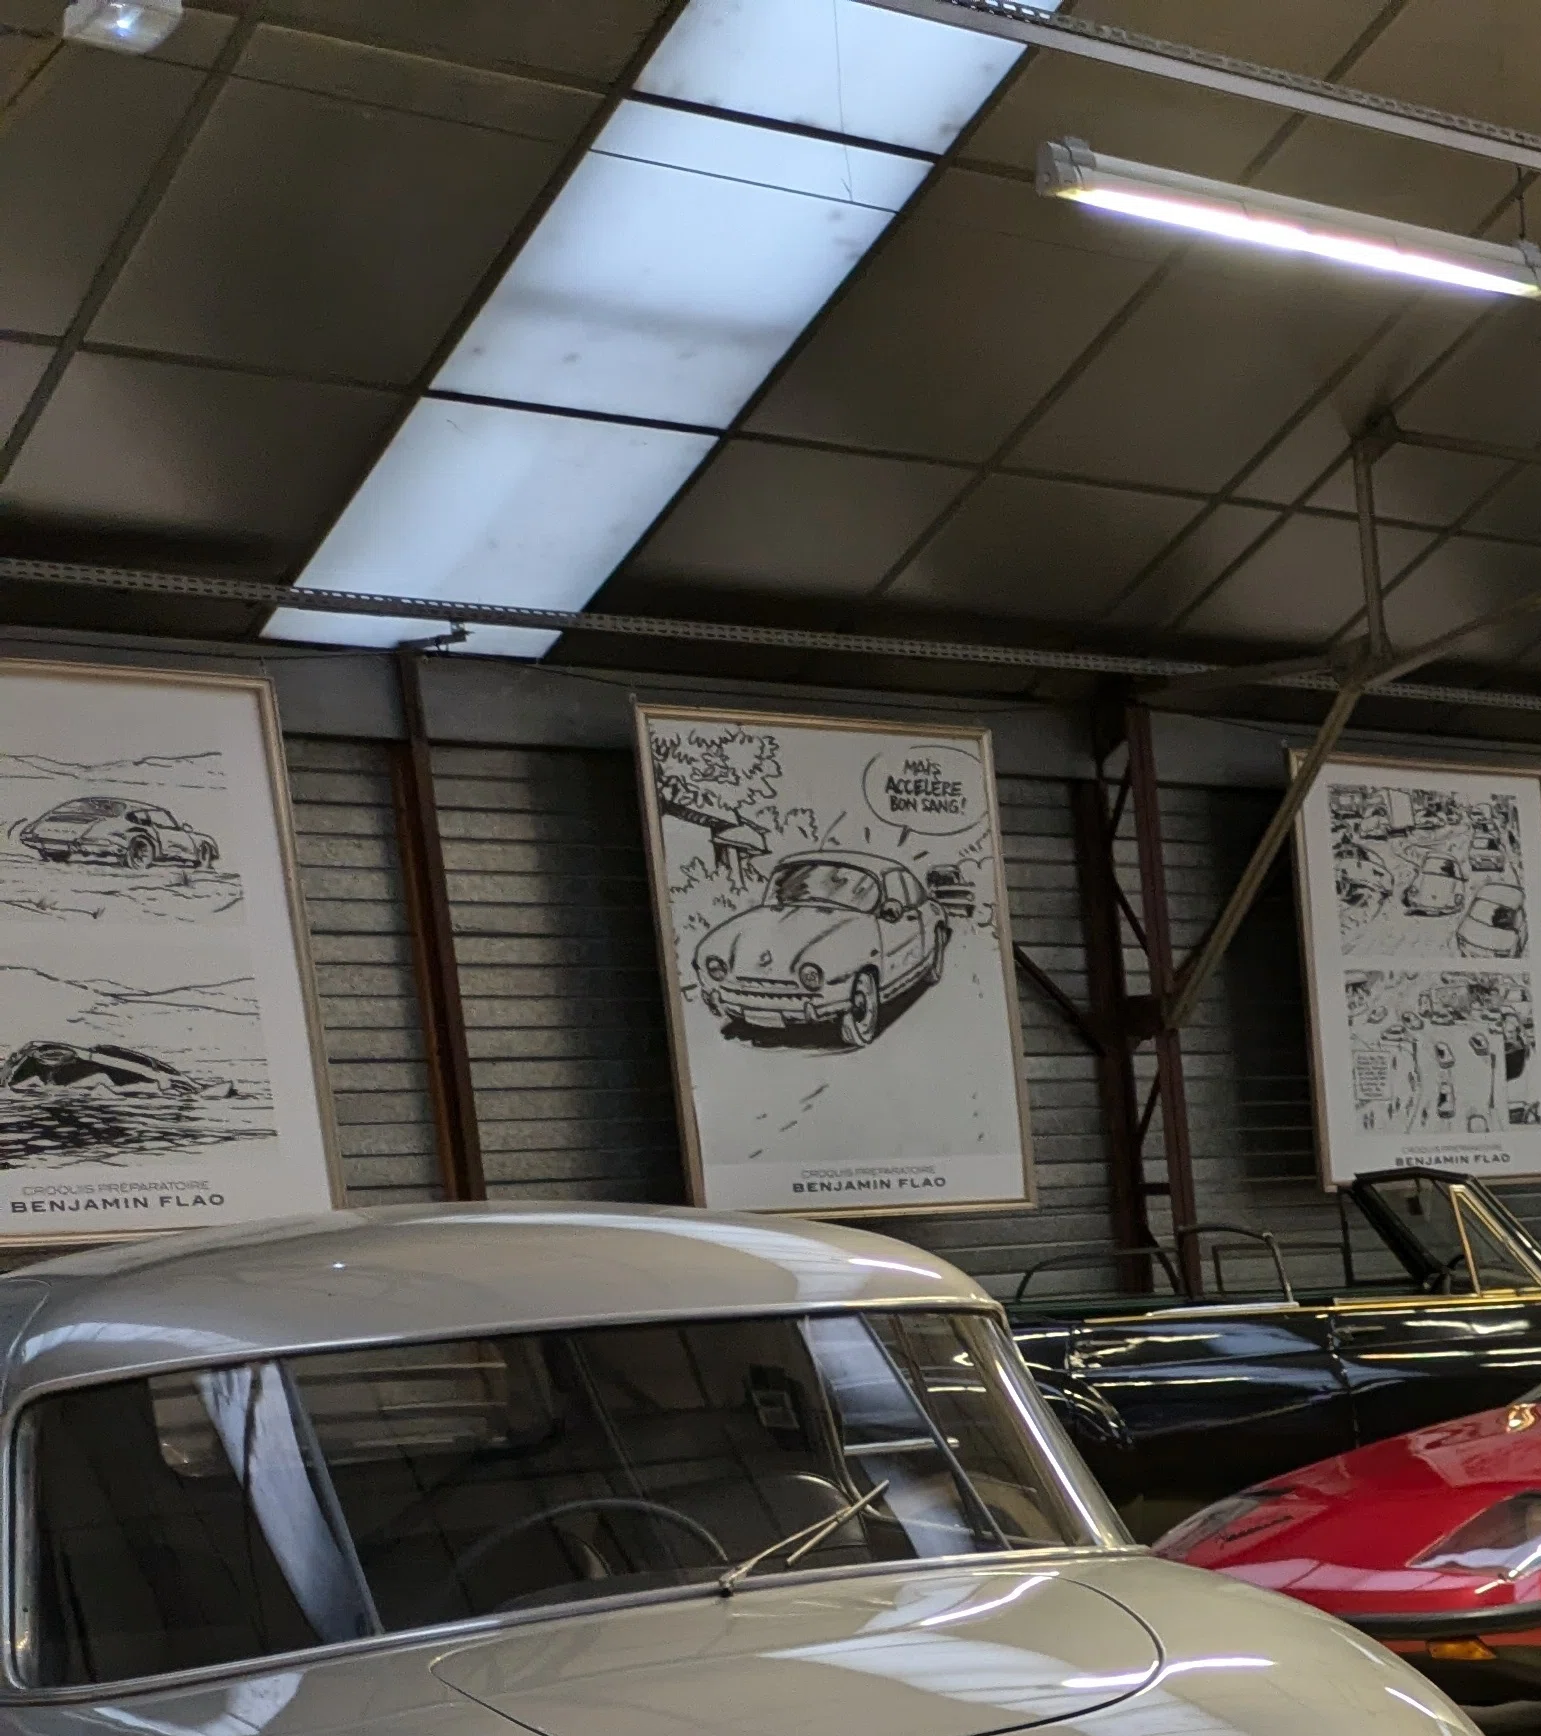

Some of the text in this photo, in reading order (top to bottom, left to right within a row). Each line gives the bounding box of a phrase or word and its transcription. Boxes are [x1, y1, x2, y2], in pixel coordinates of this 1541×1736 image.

[890, 795, 917, 812] BON
[1395, 1154, 1469, 1167] BENJAMIN
[22, 1183, 93, 1197] CROQUIS
[792, 1176, 946, 1193] BENJAMIN FLAO
[11, 1193, 225, 1213] BENJAMIN FLAO
